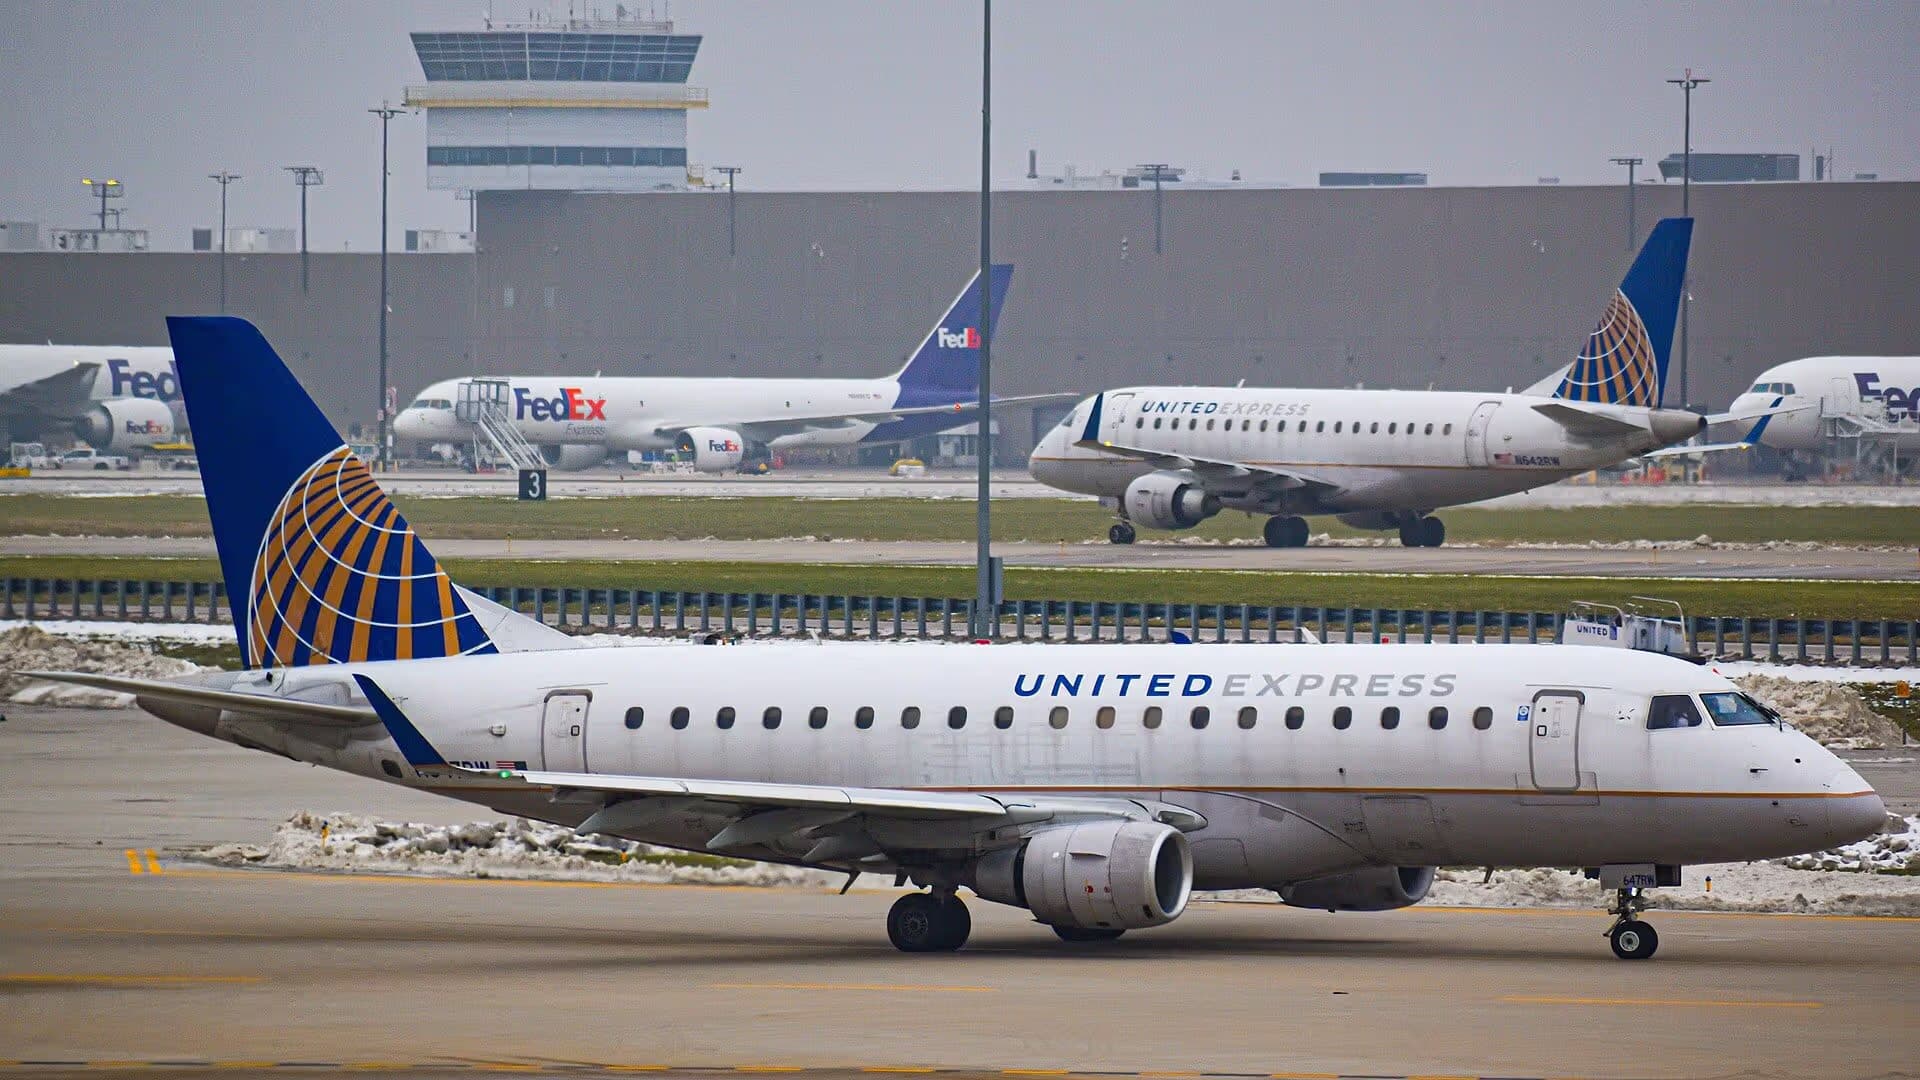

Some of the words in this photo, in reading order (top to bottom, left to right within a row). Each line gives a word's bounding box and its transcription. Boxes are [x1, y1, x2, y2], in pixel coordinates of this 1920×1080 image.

[513, 388, 606, 422] FedEx
[1141, 401, 1218, 414] UNITED
[1219, 402, 1311, 416] EXPRESS
[126, 420, 162, 434] FedEx
[709, 439, 739, 452] FedEx
[528, 472, 540, 498] 3
[1577, 625, 1608, 636] UNITED
[1014, 674, 1213, 697] UNITED
[1222, 674, 1457, 697] EXPRESS
